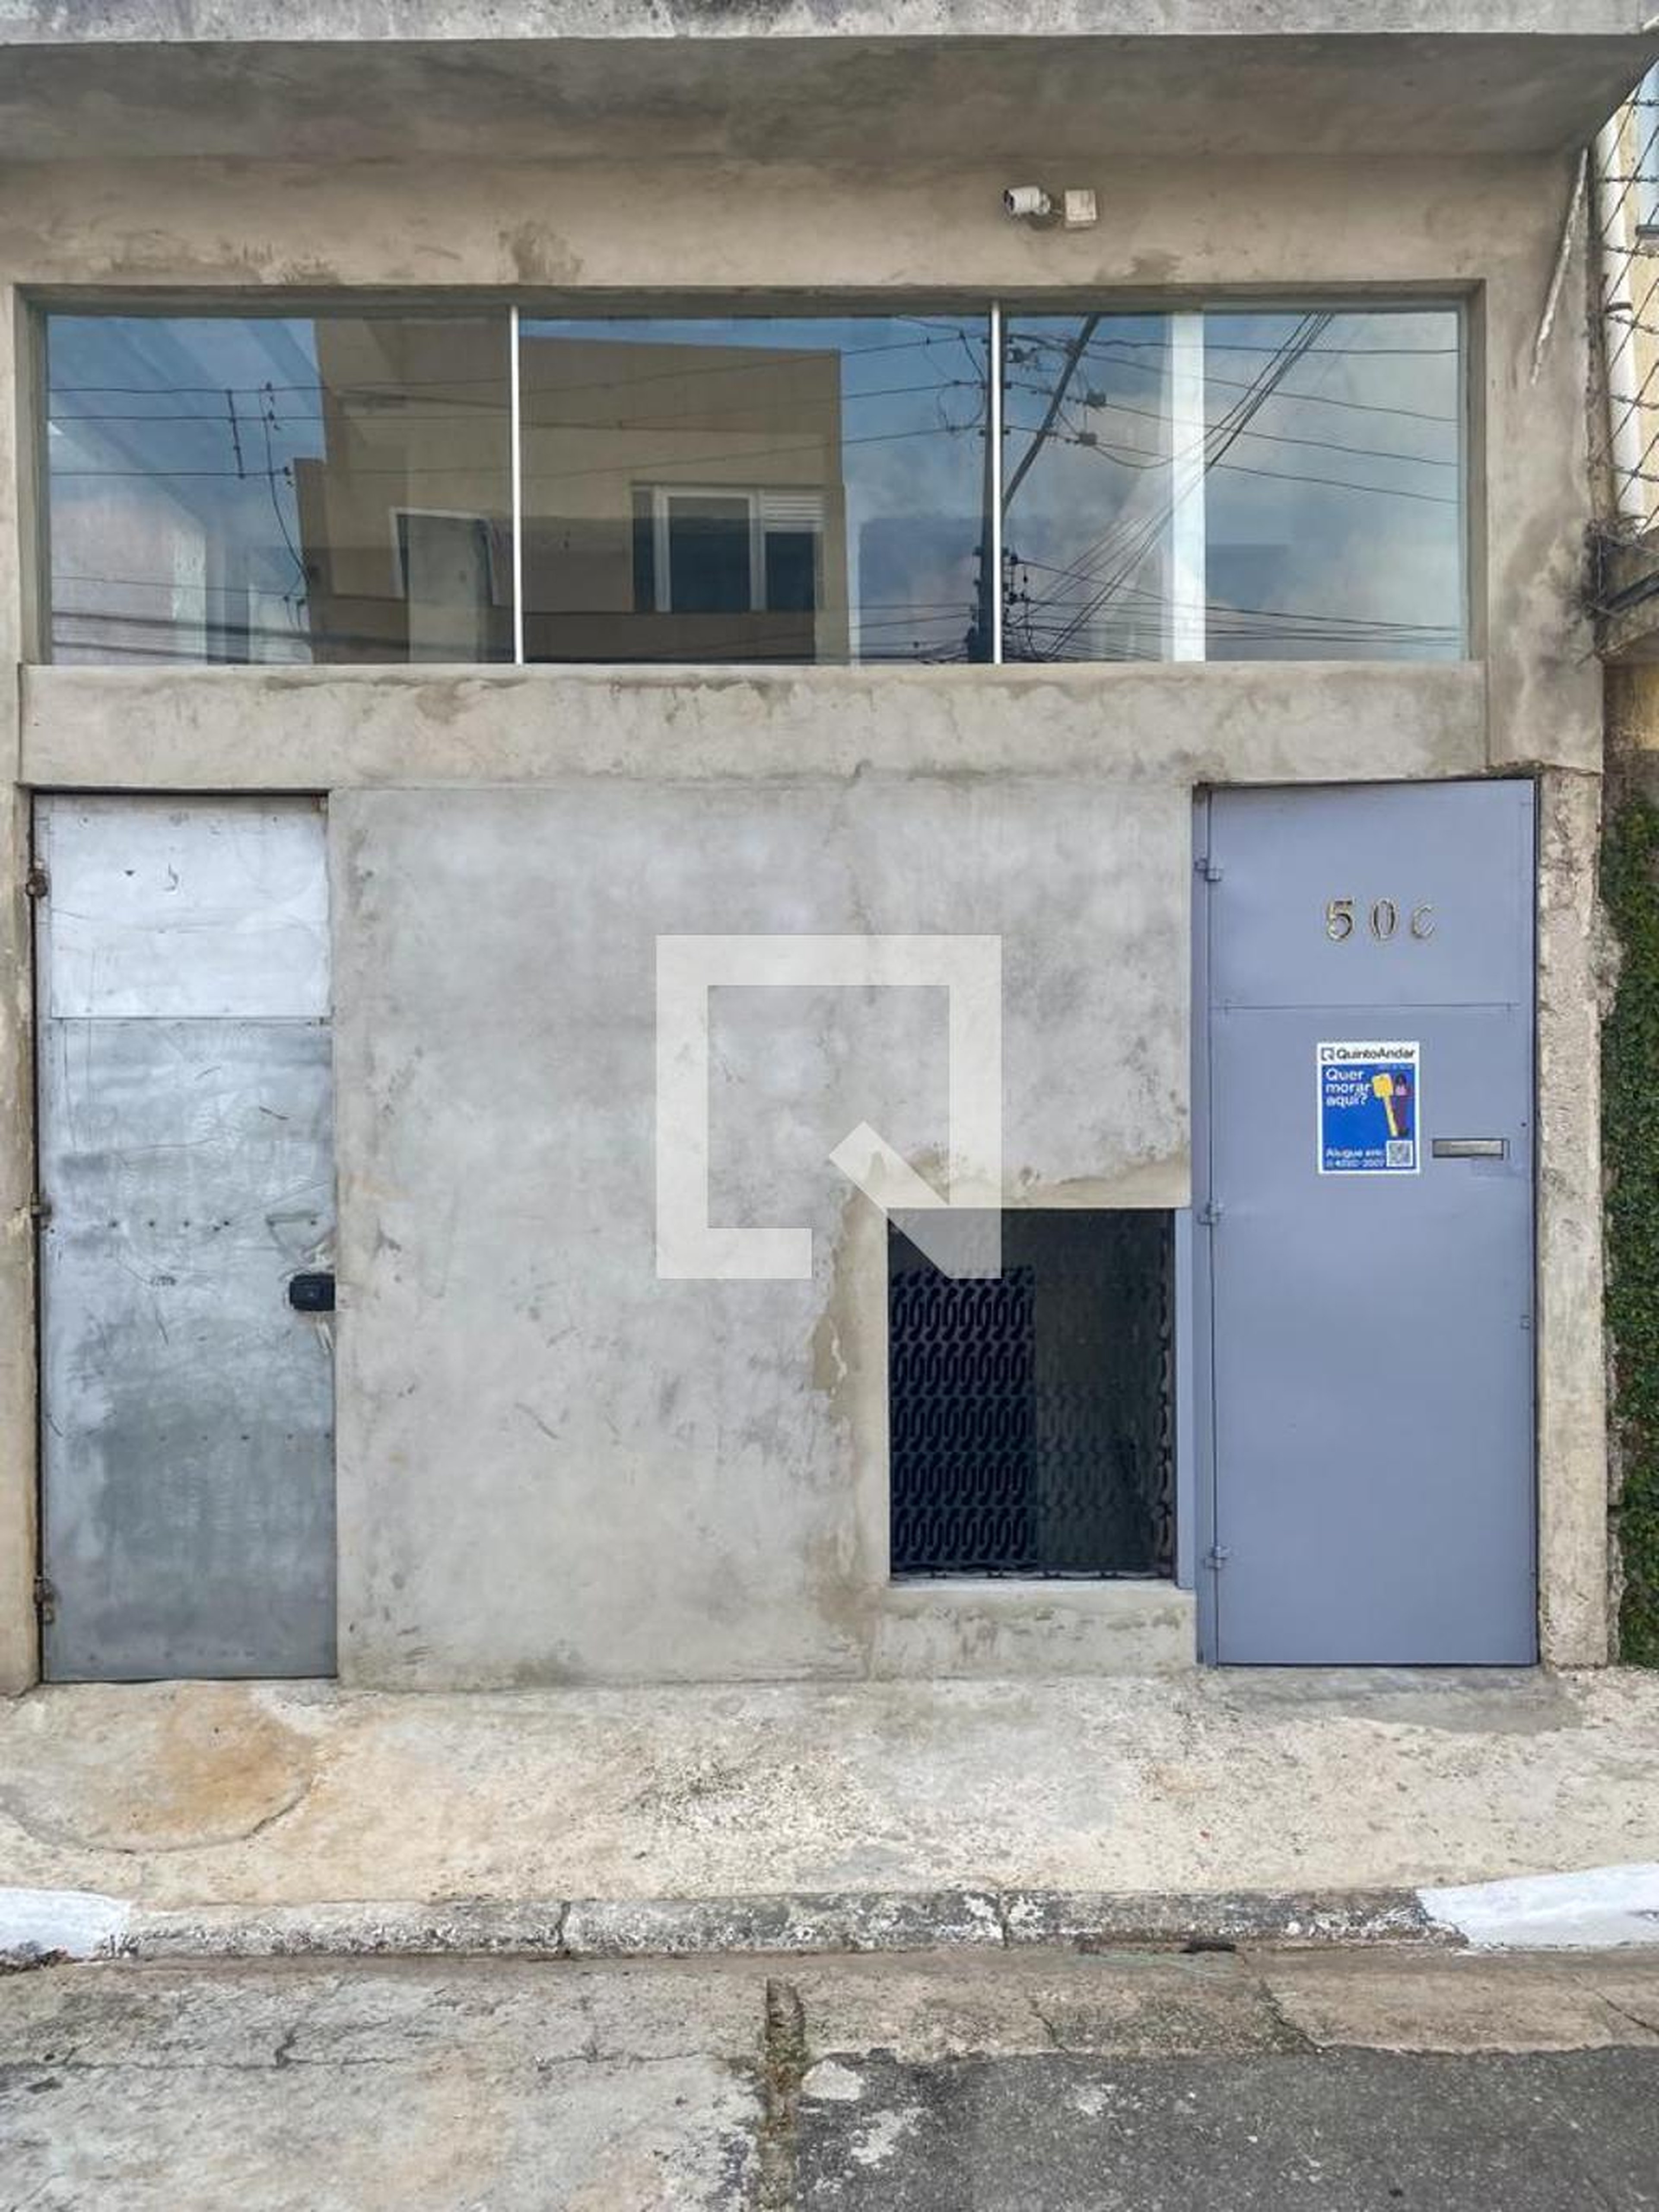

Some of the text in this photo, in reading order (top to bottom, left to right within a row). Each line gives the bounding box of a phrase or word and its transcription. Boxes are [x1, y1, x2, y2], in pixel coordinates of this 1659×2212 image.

[1336, 1047, 1415, 1059] QuintoAndar
[1326, 1067, 1364, 1081] Quer
[1326, 1083, 1372, 1094] morar
